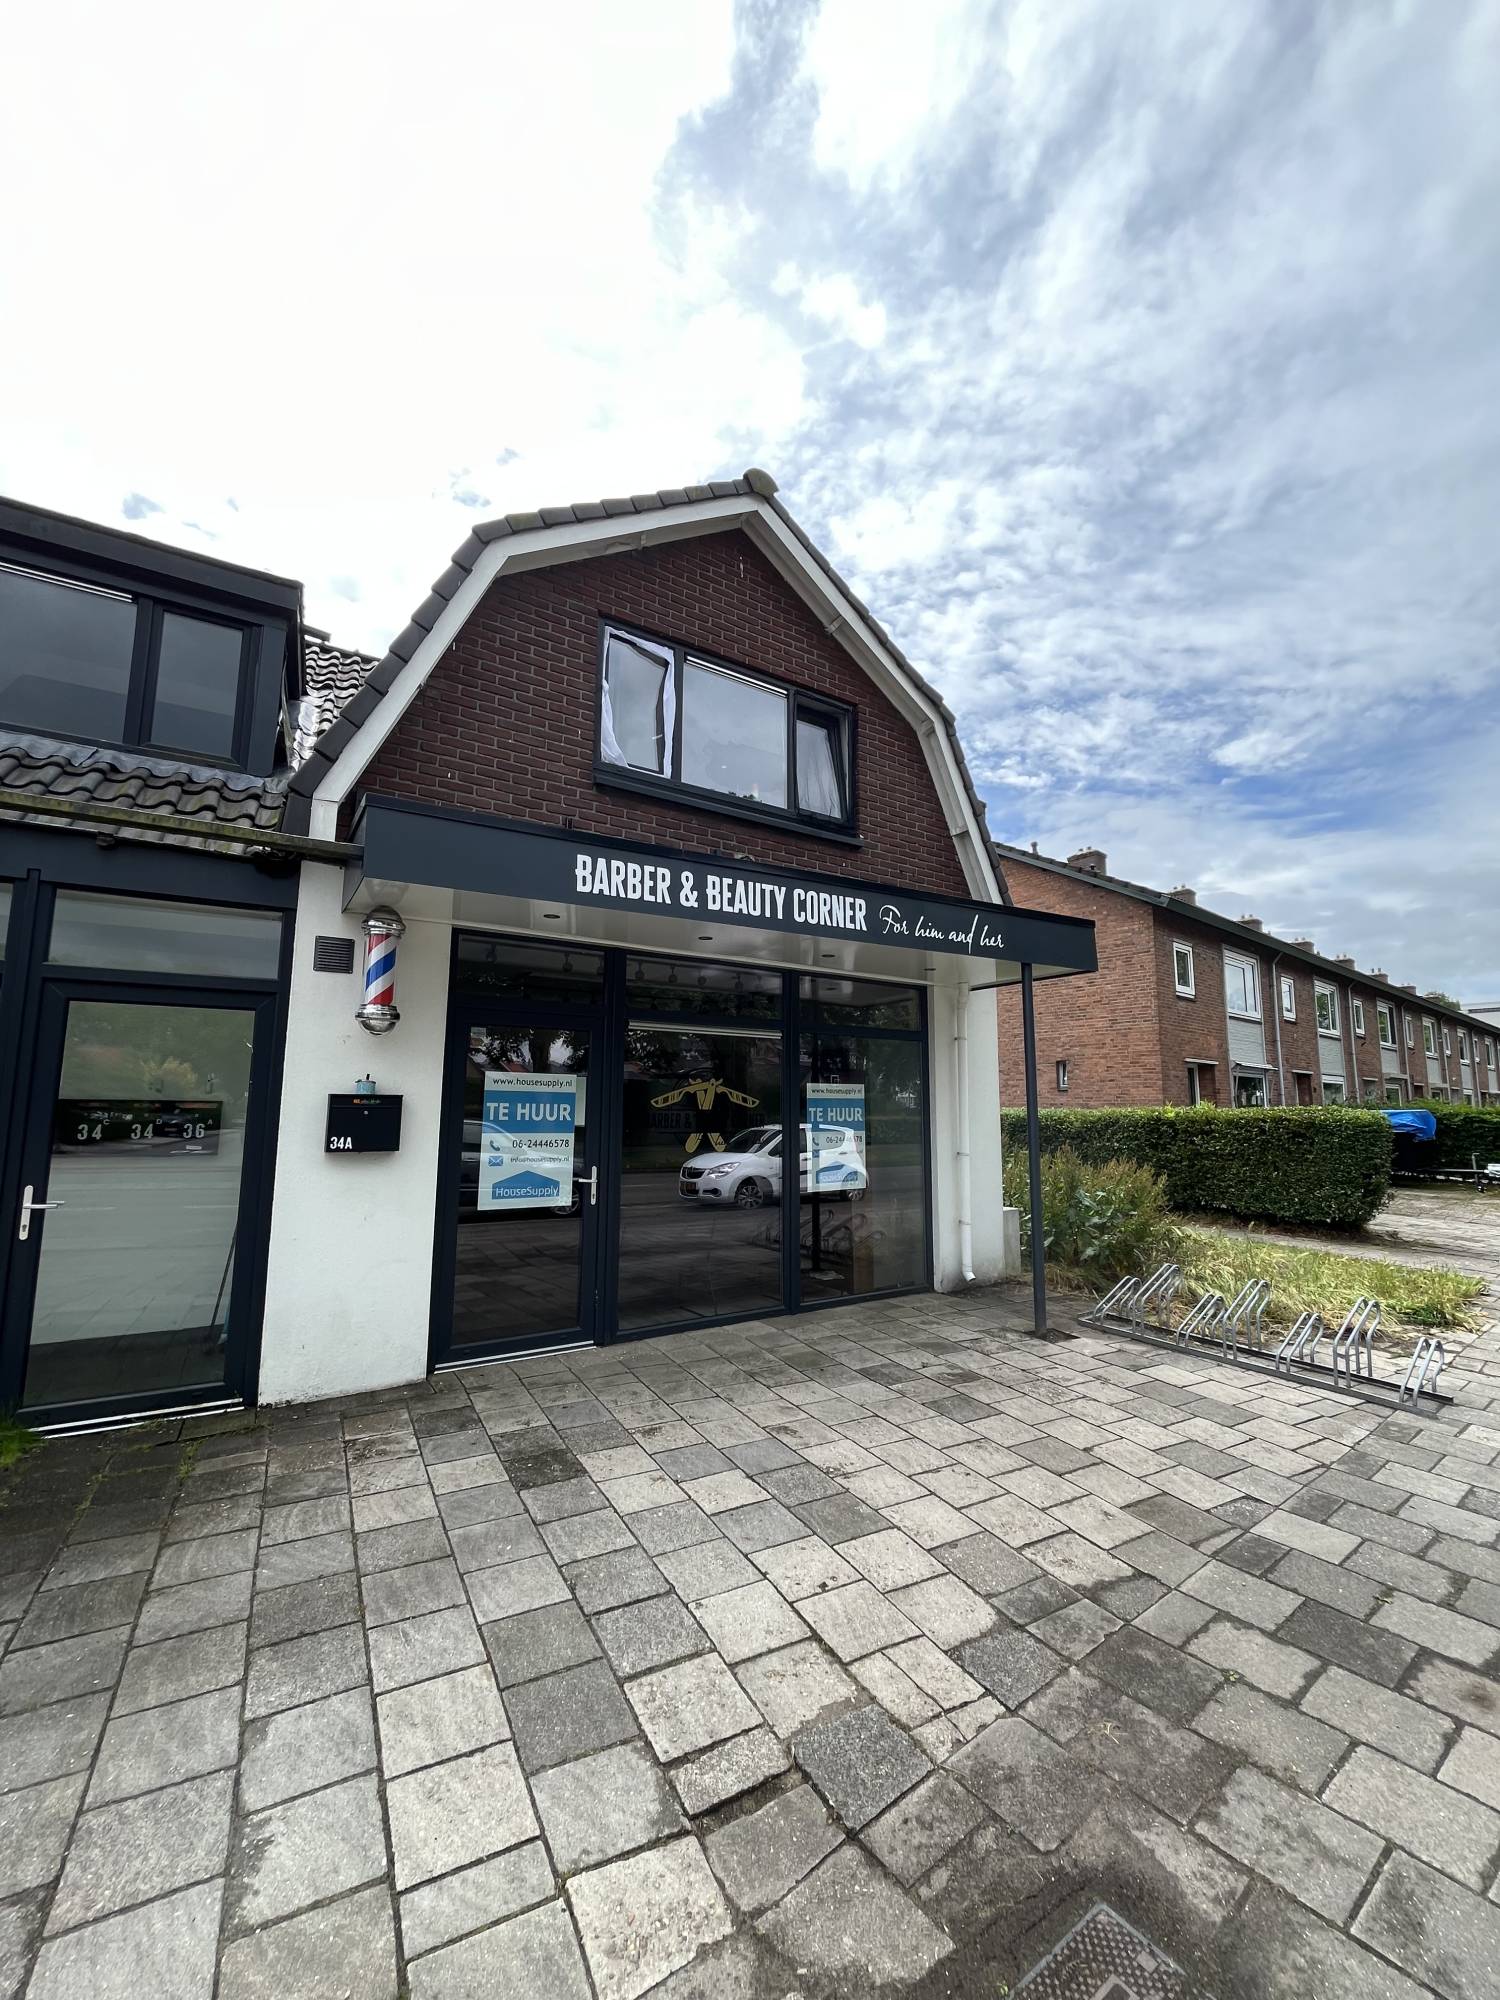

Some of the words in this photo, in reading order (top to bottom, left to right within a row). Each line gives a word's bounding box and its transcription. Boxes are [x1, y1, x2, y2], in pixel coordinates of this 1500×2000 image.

[575, 854, 672, 905] BARBER
[679, 871, 699, 908] &
[706, 874, 786, 920] BEAUTY
[793, 888, 867, 931] CORNER
[879, 904, 909, 934] For
[915, 915, 944, 939] him
[949, 914, 979, 954] and
[980, 925, 1004, 948] her
[493, 1078, 573, 1088] www.housesupply.nl
[811, 1087, 863, 1096] www.housesupply.nl
[486, 1102, 509, 1121] TE
[516, 1103, 572, 1121] HUUR
[808, 1107, 824, 1122] TE
[827, 1107, 863, 1122] HUUR
[329, 1136, 353, 1150] 34A
[512, 1139, 570, 1148] 06-24446578
[495, 1186, 559, 1198] HouseSupply
